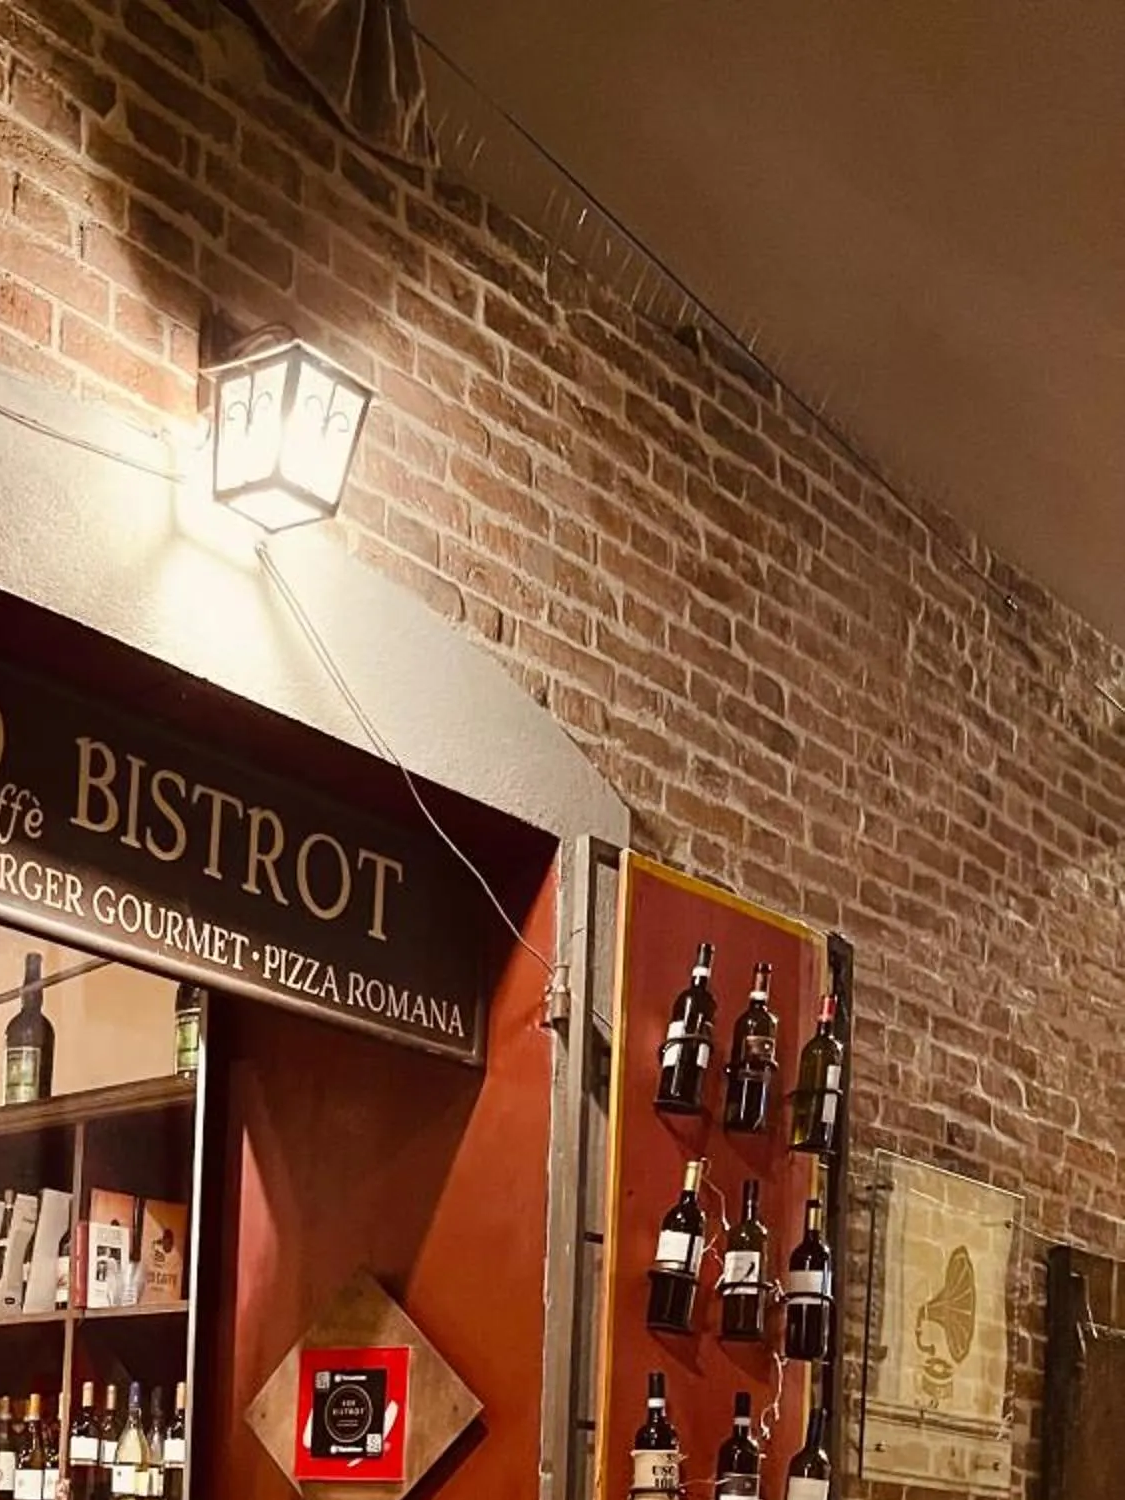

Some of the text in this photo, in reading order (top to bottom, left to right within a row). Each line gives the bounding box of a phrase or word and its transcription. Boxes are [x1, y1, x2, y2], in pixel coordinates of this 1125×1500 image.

[69, 736, 404, 941] BISTROT
[92, 885, 251, 971] GOURMET
[262, 943, 341, 1004] PIZZA
[346, 970, 465, 1038] ROMANA
